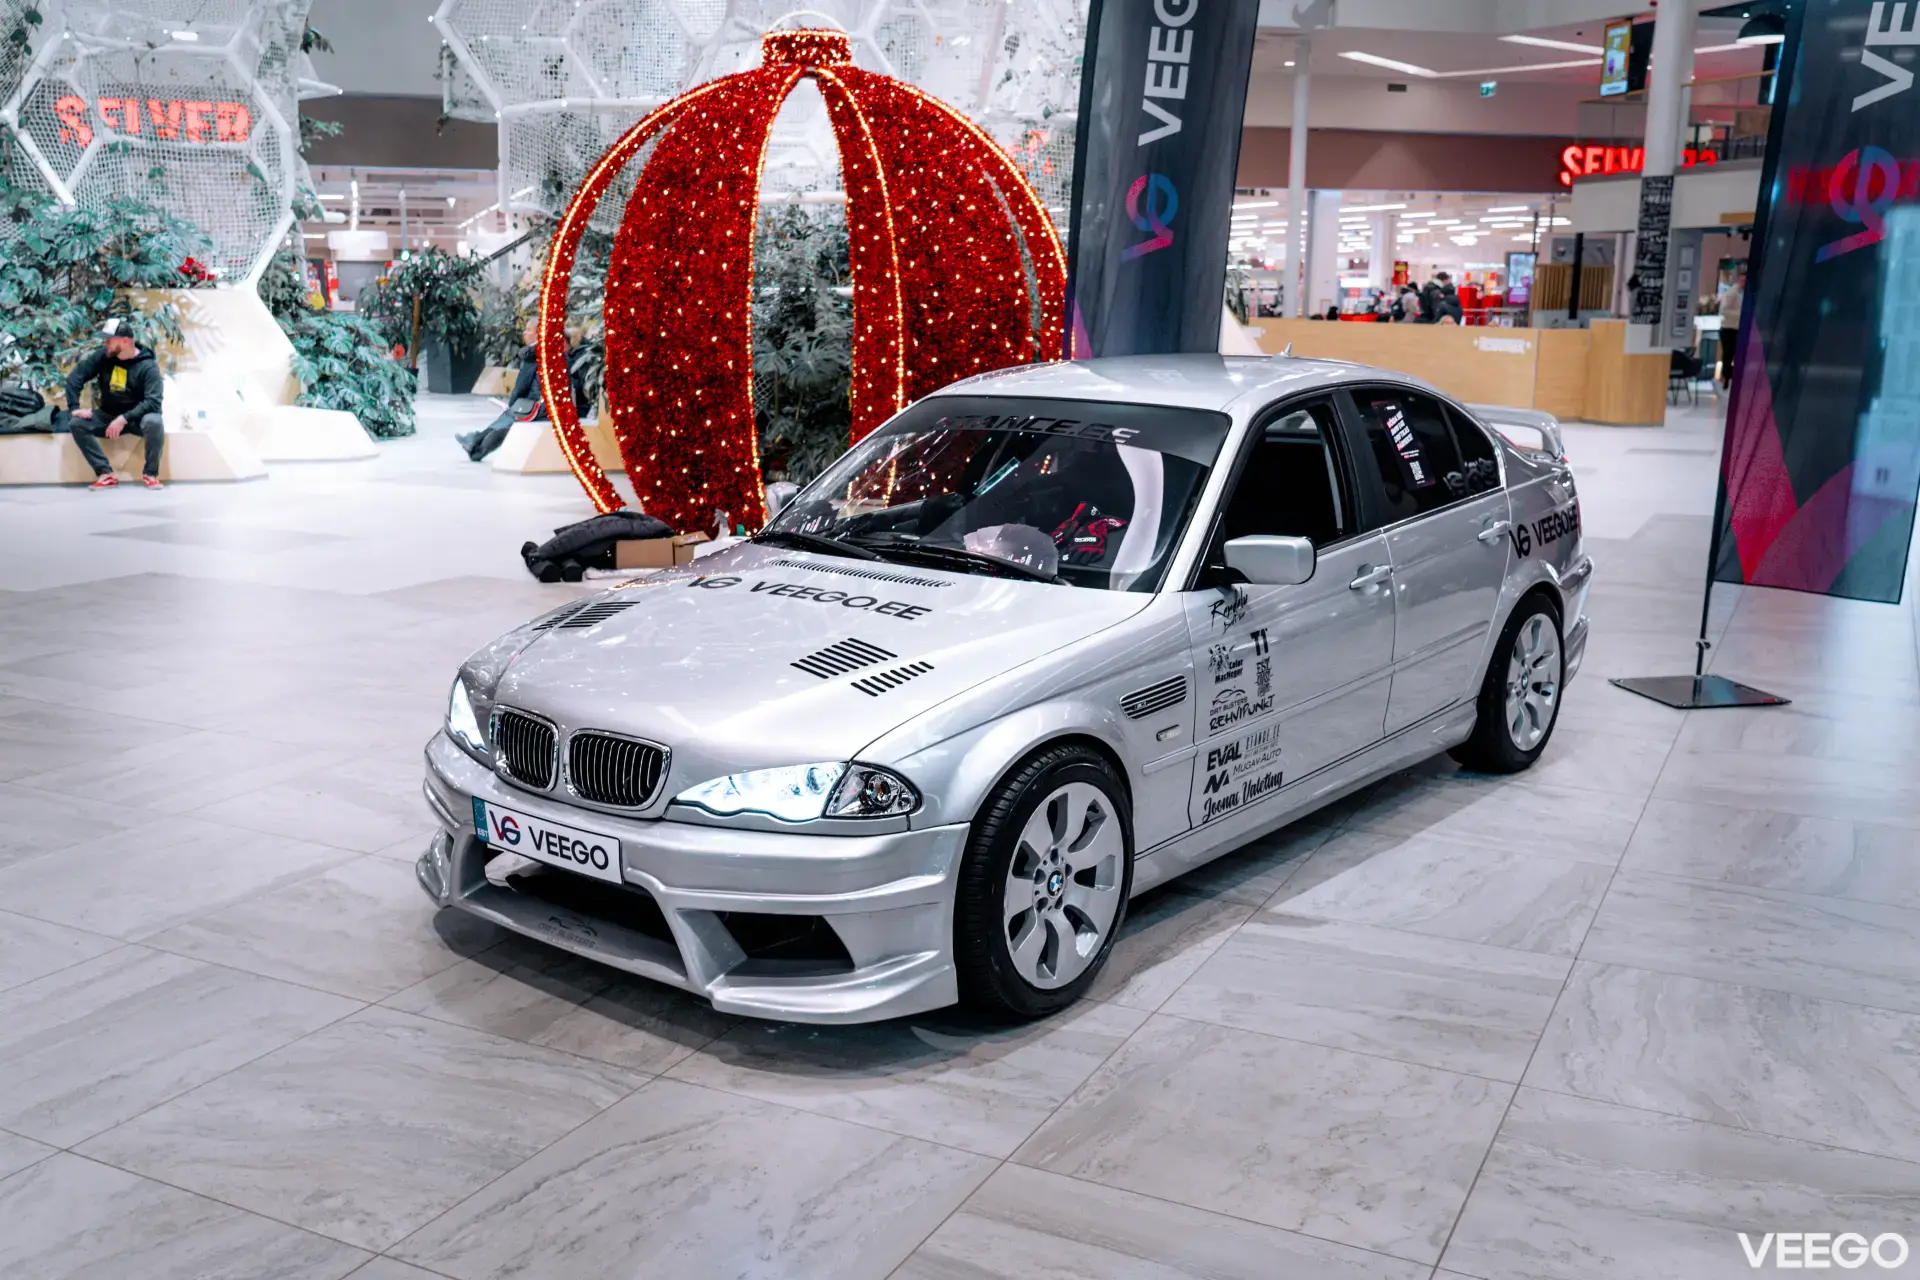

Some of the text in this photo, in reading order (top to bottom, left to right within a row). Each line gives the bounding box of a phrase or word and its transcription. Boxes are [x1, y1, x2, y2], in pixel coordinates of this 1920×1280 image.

[749, 581, 933, 621] VEEGO.EE
[1209, 696, 1248, 717] DIRT BUSTERS
[477, 827, 489, 837] EST
[527, 825, 609, 871] VEEGO
